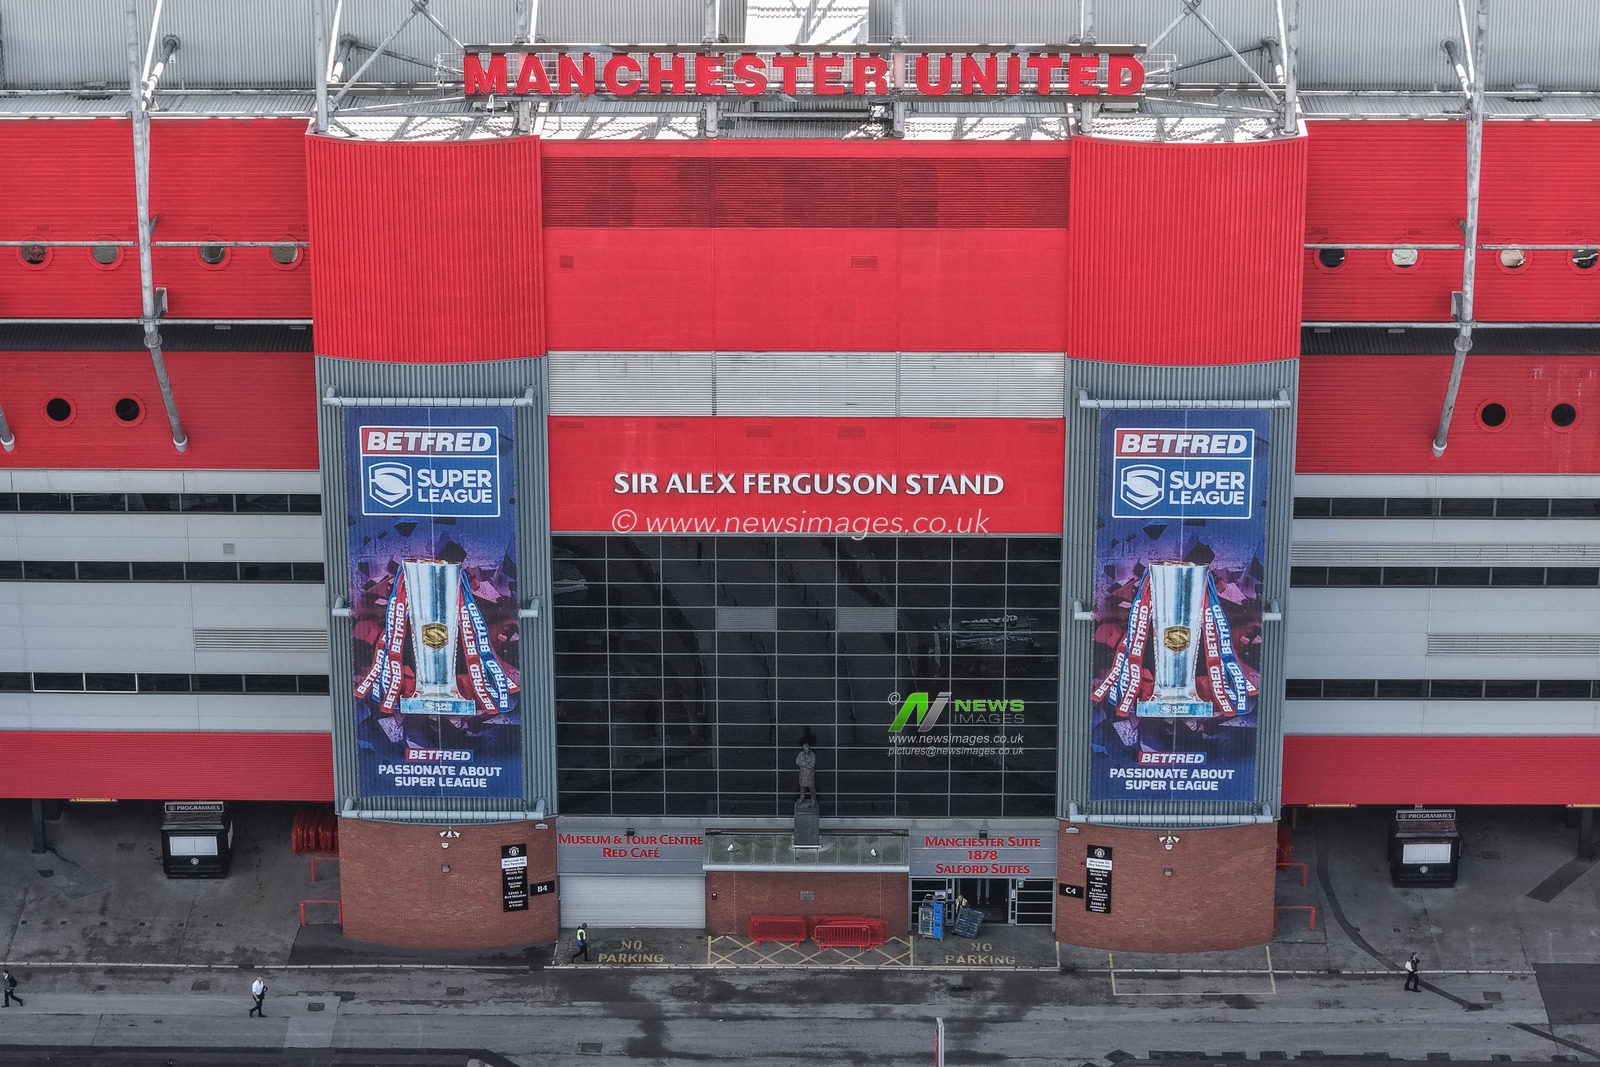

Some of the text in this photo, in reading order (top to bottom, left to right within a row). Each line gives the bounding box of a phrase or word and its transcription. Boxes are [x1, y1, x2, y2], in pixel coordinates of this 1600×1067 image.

[462, 54, 1146, 96] MANCHESTER UNITED
[367, 432, 492, 452] BETFRED
[1121, 434, 1247, 454] BETFRED
[417, 469, 492, 488] SUPER
[613, 472, 1004, 496] SIR ALEX FERGUSON STAND
[1169, 471, 1245, 490] SUPER
[418, 488, 492, 504] LEAGUE
[1169, 490, 1245, 506] LEAGUE
[391, 602, 405, 654] BETFRED
[461, 605, 477, 656] BETFRED
[468, 602, 491, 653] BETFRED
[1132, 605, 1149, 656] BETFRED
[1205, 607, 1219, 658] BETFRED
[1212, 604, 1233, 655] BETFRED
[357, 649, 385, 694] BETFRED
[1093, 652, 1125, 698] BETFRED
[383, 660, 402, 709] BETFRED
[470, 663, 496, 710] BETFRED
[486, 660, 509, 708] BETFRED
[1119, 663, 1141, 712] BETFRED
[1210, 665, 1233, 712] BETFRED
[1227, 662, 1246, 710] BETFRED
[408, 750, 471, 761] BETFRED
[1141, 753, 1205, 764] BETFRED
[378, 764, 502, 777] PASSIONATE ABOUT
[1109, 768, 1235, 780] PASSIONATE ABOUT
[395, 776, 488, 788] SUPER LEAGUE
[1125, 780, 1219, 791] SUPER LEAGUE
[613, 835, 623, 845] &
[967, 850, 998, 860] 1878
[537, 885, 548, 893] B4
[1065, 886, 1077, 895] C4
[621, 940, 643, 950] NO
[970, 942, 993, 952] NO
[598, 953, 665, 963] PARKING
[945, 954, 1016, 965] PARKING
